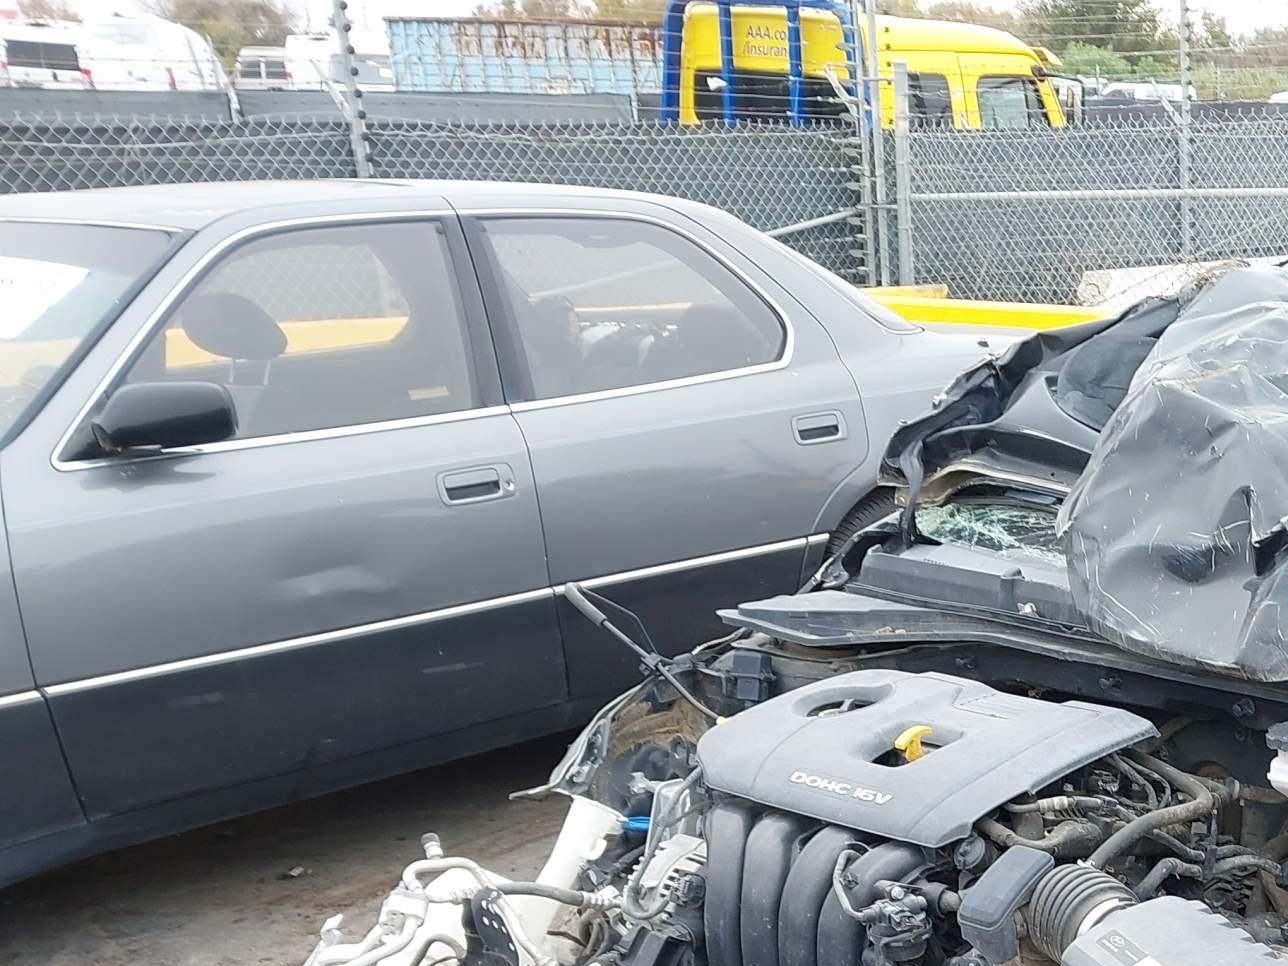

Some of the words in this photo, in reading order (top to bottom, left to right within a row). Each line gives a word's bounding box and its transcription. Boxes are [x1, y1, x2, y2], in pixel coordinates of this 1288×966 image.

[745, 24, 787, 41] AAA.co
[743, 41, 787, 57] /insuran
[789, 771, 852, 795] DOHC
[851, 786, 894, 805] 16V
